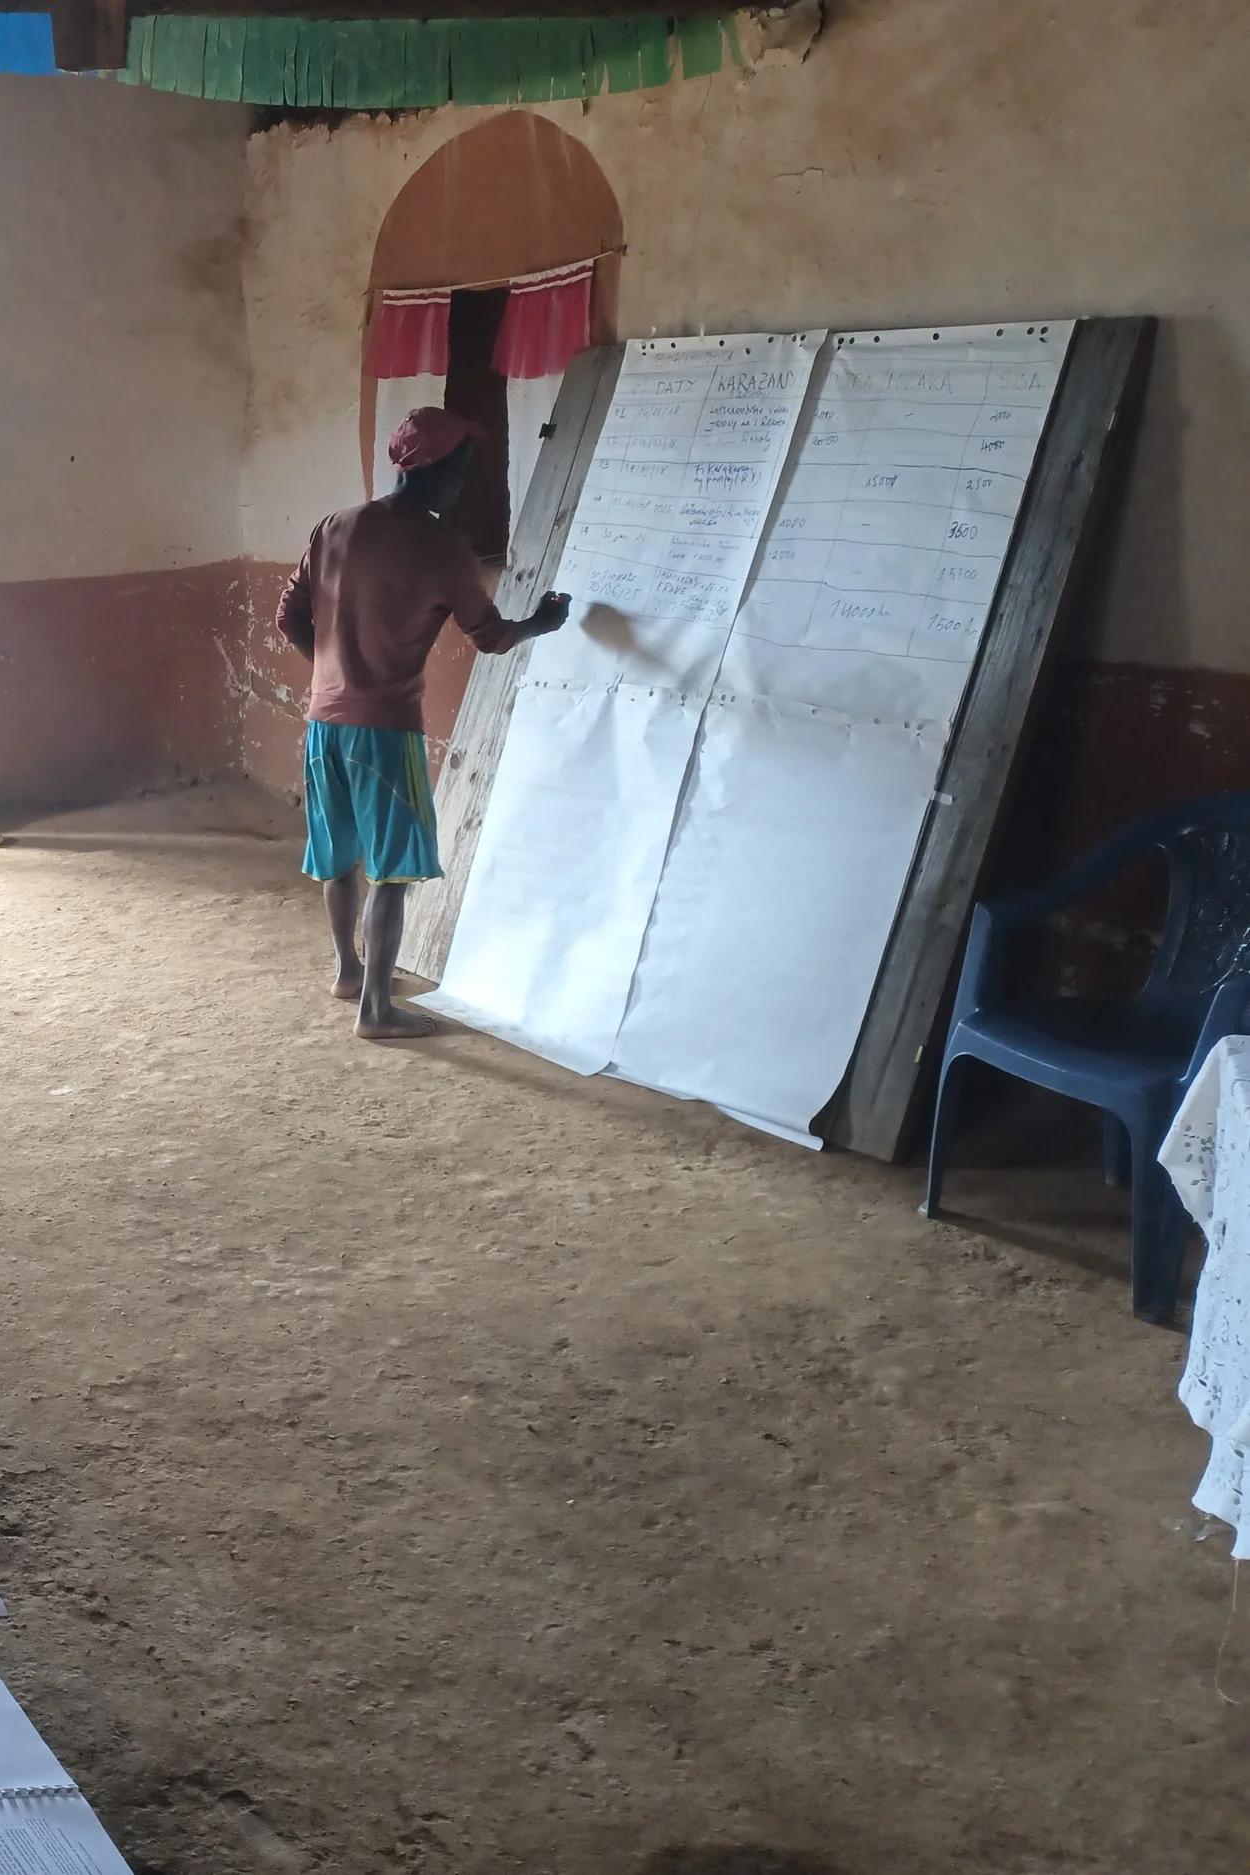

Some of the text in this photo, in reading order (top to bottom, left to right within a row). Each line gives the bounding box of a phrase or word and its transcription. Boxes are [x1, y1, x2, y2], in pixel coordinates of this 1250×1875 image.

[655, 379, 698, 396] DATY
[997, 373, 1044, 391] SISA
[778, 517, 806, 529] 1000
[927, 612, 962, 632] 1500
